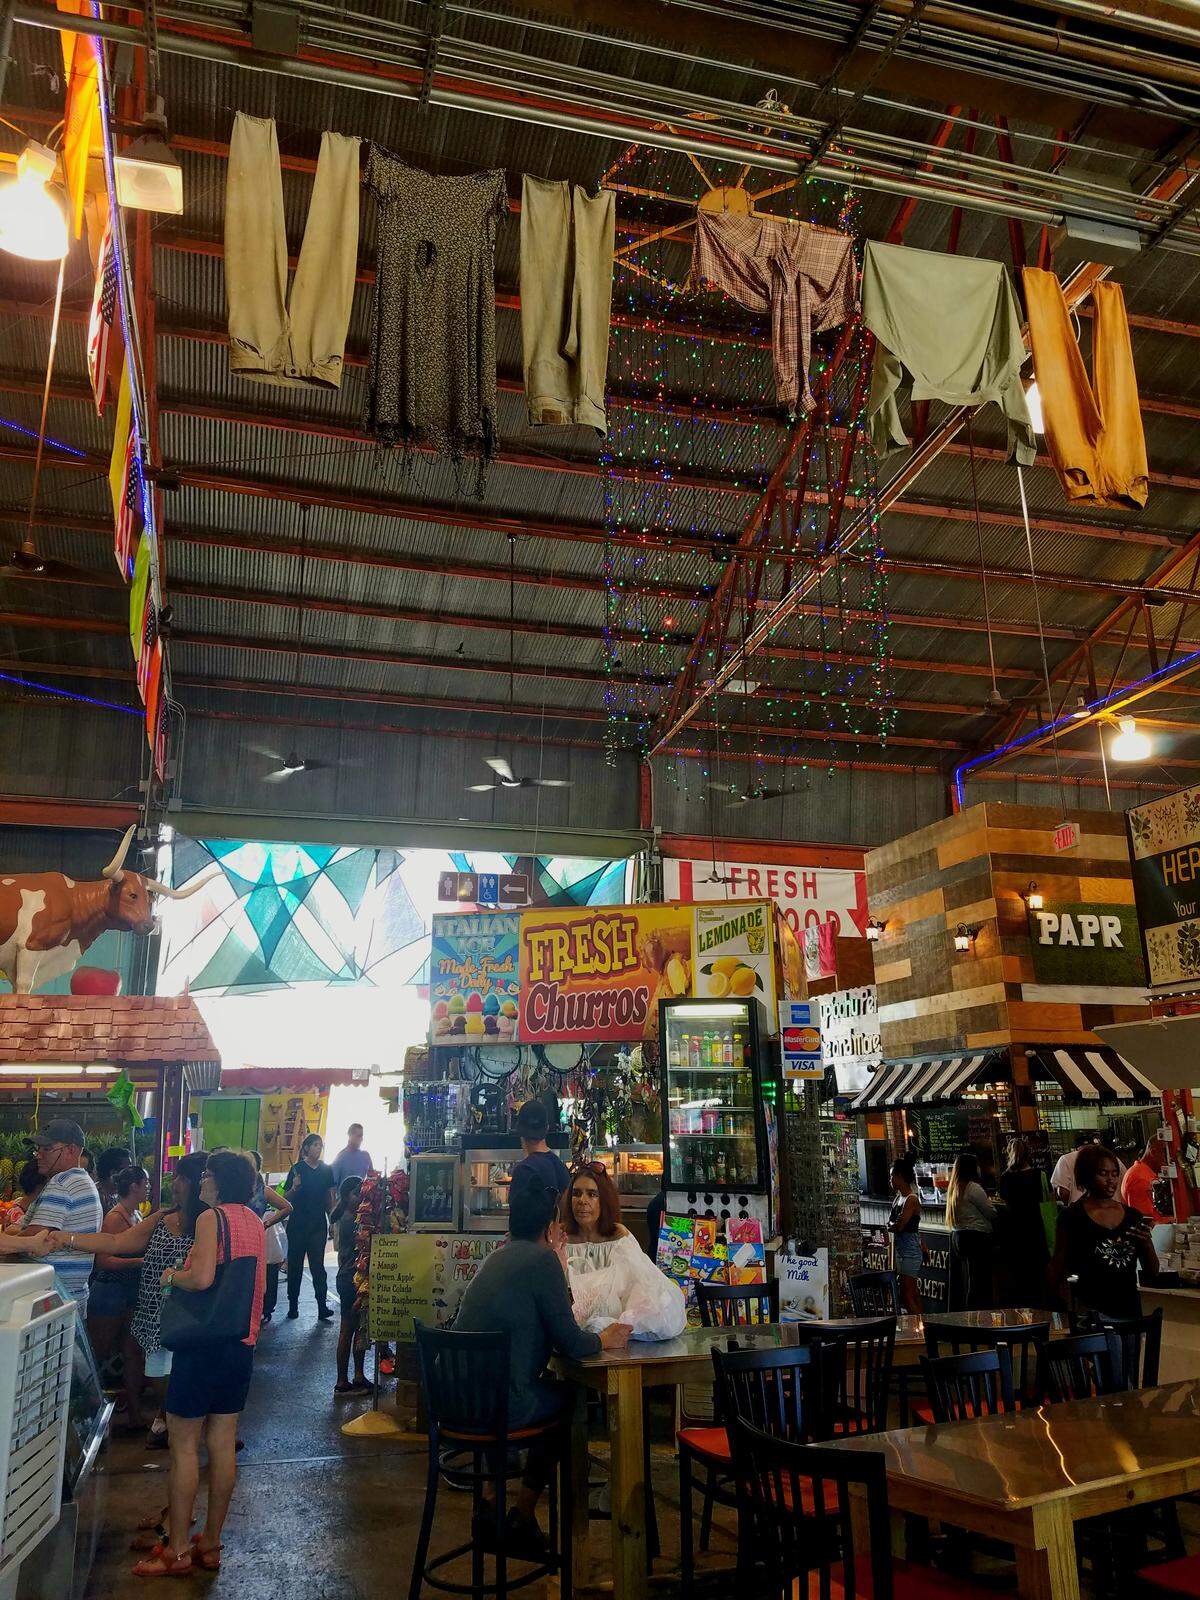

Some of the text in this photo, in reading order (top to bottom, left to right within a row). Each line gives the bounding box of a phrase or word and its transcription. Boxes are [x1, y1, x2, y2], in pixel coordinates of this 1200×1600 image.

[1056, 826, 1073, 849] EXIT
[729, 867, 818, 900] FRESH
[1173, 901, 1196, 917] Your
[433, 917, 520, 937] ITALIAN
[698, 907, 763, 953] LEMONADE
[784, 907, 841, 937] OOD
[1036, 912, 1124, 948] PAPR
[456, 936, 495, 955] ICE
[526, 919, 638, 982] FRESH
[438, 956, 514, 975] Made Fresh
[460, 971, 493, 995] Daily
[525, 981, 649, 1034] Churros
[784, 1034, 820, 1044] MasterCard
[791, 1060, 816, 1071] VISA
[377, 1249, 399, 1259] Lemon
[451, 1239, 483, 1260] REAL
[377, 1261, 398, 1272] Mango
[781, 1254, 818, 1268] The good
[921, 1250, 950, 1270] WAY
[376, 1272, 414, 1283] Green Apple
[786, 1269, 810, 1282] Milk
[392, 1284, 412, 1293] Colada
[392, 1307, 410, 1318] Apple
